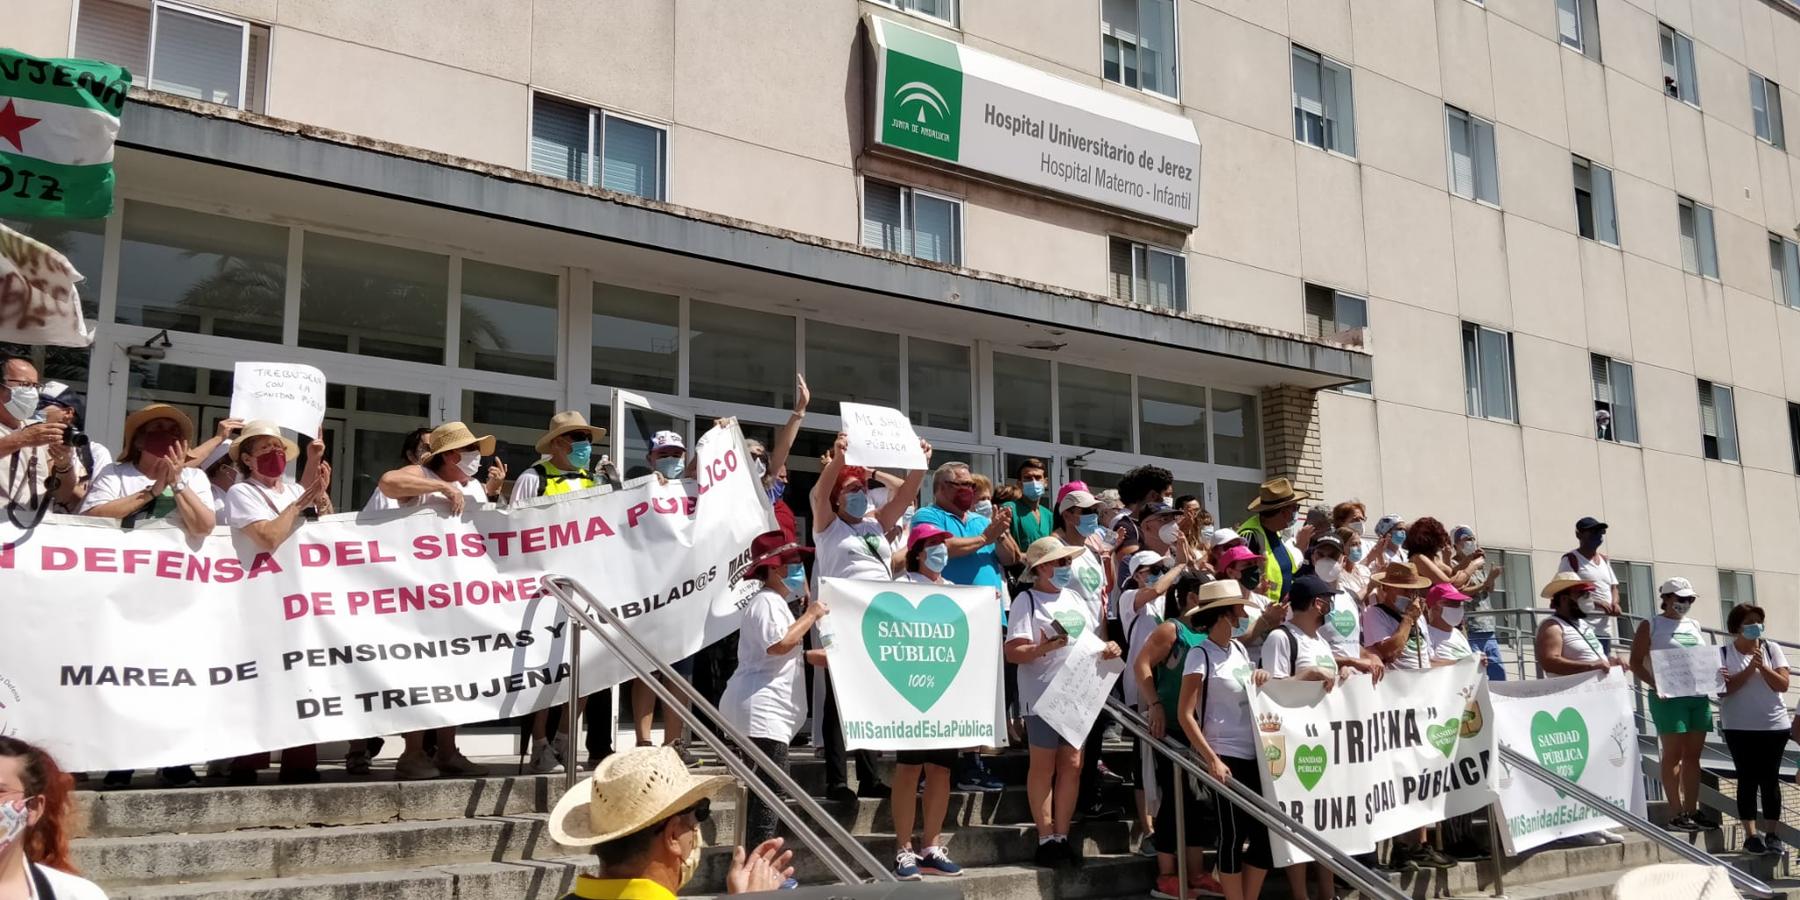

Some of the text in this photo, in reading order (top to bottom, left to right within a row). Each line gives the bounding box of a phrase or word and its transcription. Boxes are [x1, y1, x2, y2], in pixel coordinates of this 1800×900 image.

[891, 118, 910, 131] JUNTA
[911, 123, 919, 134] DE
[985, 103, 1193, 182] Hospital Universitario de Jerez
[1041, 151, 1092, 185] Hospital
[1095, 166, 1144, 198] Materno
[1153, 182, 1192, 211] Infantil
[41, 544, 283, 583] DEFENSA
[298, 540, 396, 568] DEL
[412, 516, 616, 561] SISTEMA
[282, 591, 335, 621] DE
[877, 619, 956, 640] SANIDAD
[282, 629, 536, 671] PENSIONISTAS
[544, 621, 566, 639] Y
[878, 641, 957, 664] PÚBLICA
[60, 660, 259, 687] MAREA DE
[907, 673, 936, 689] 100%
[295, 662, 571, 720] DE TREBUJENA
[1537, 730, 1580, 748] SANIDAD
[1314, 795, 1358, 832] UNA
